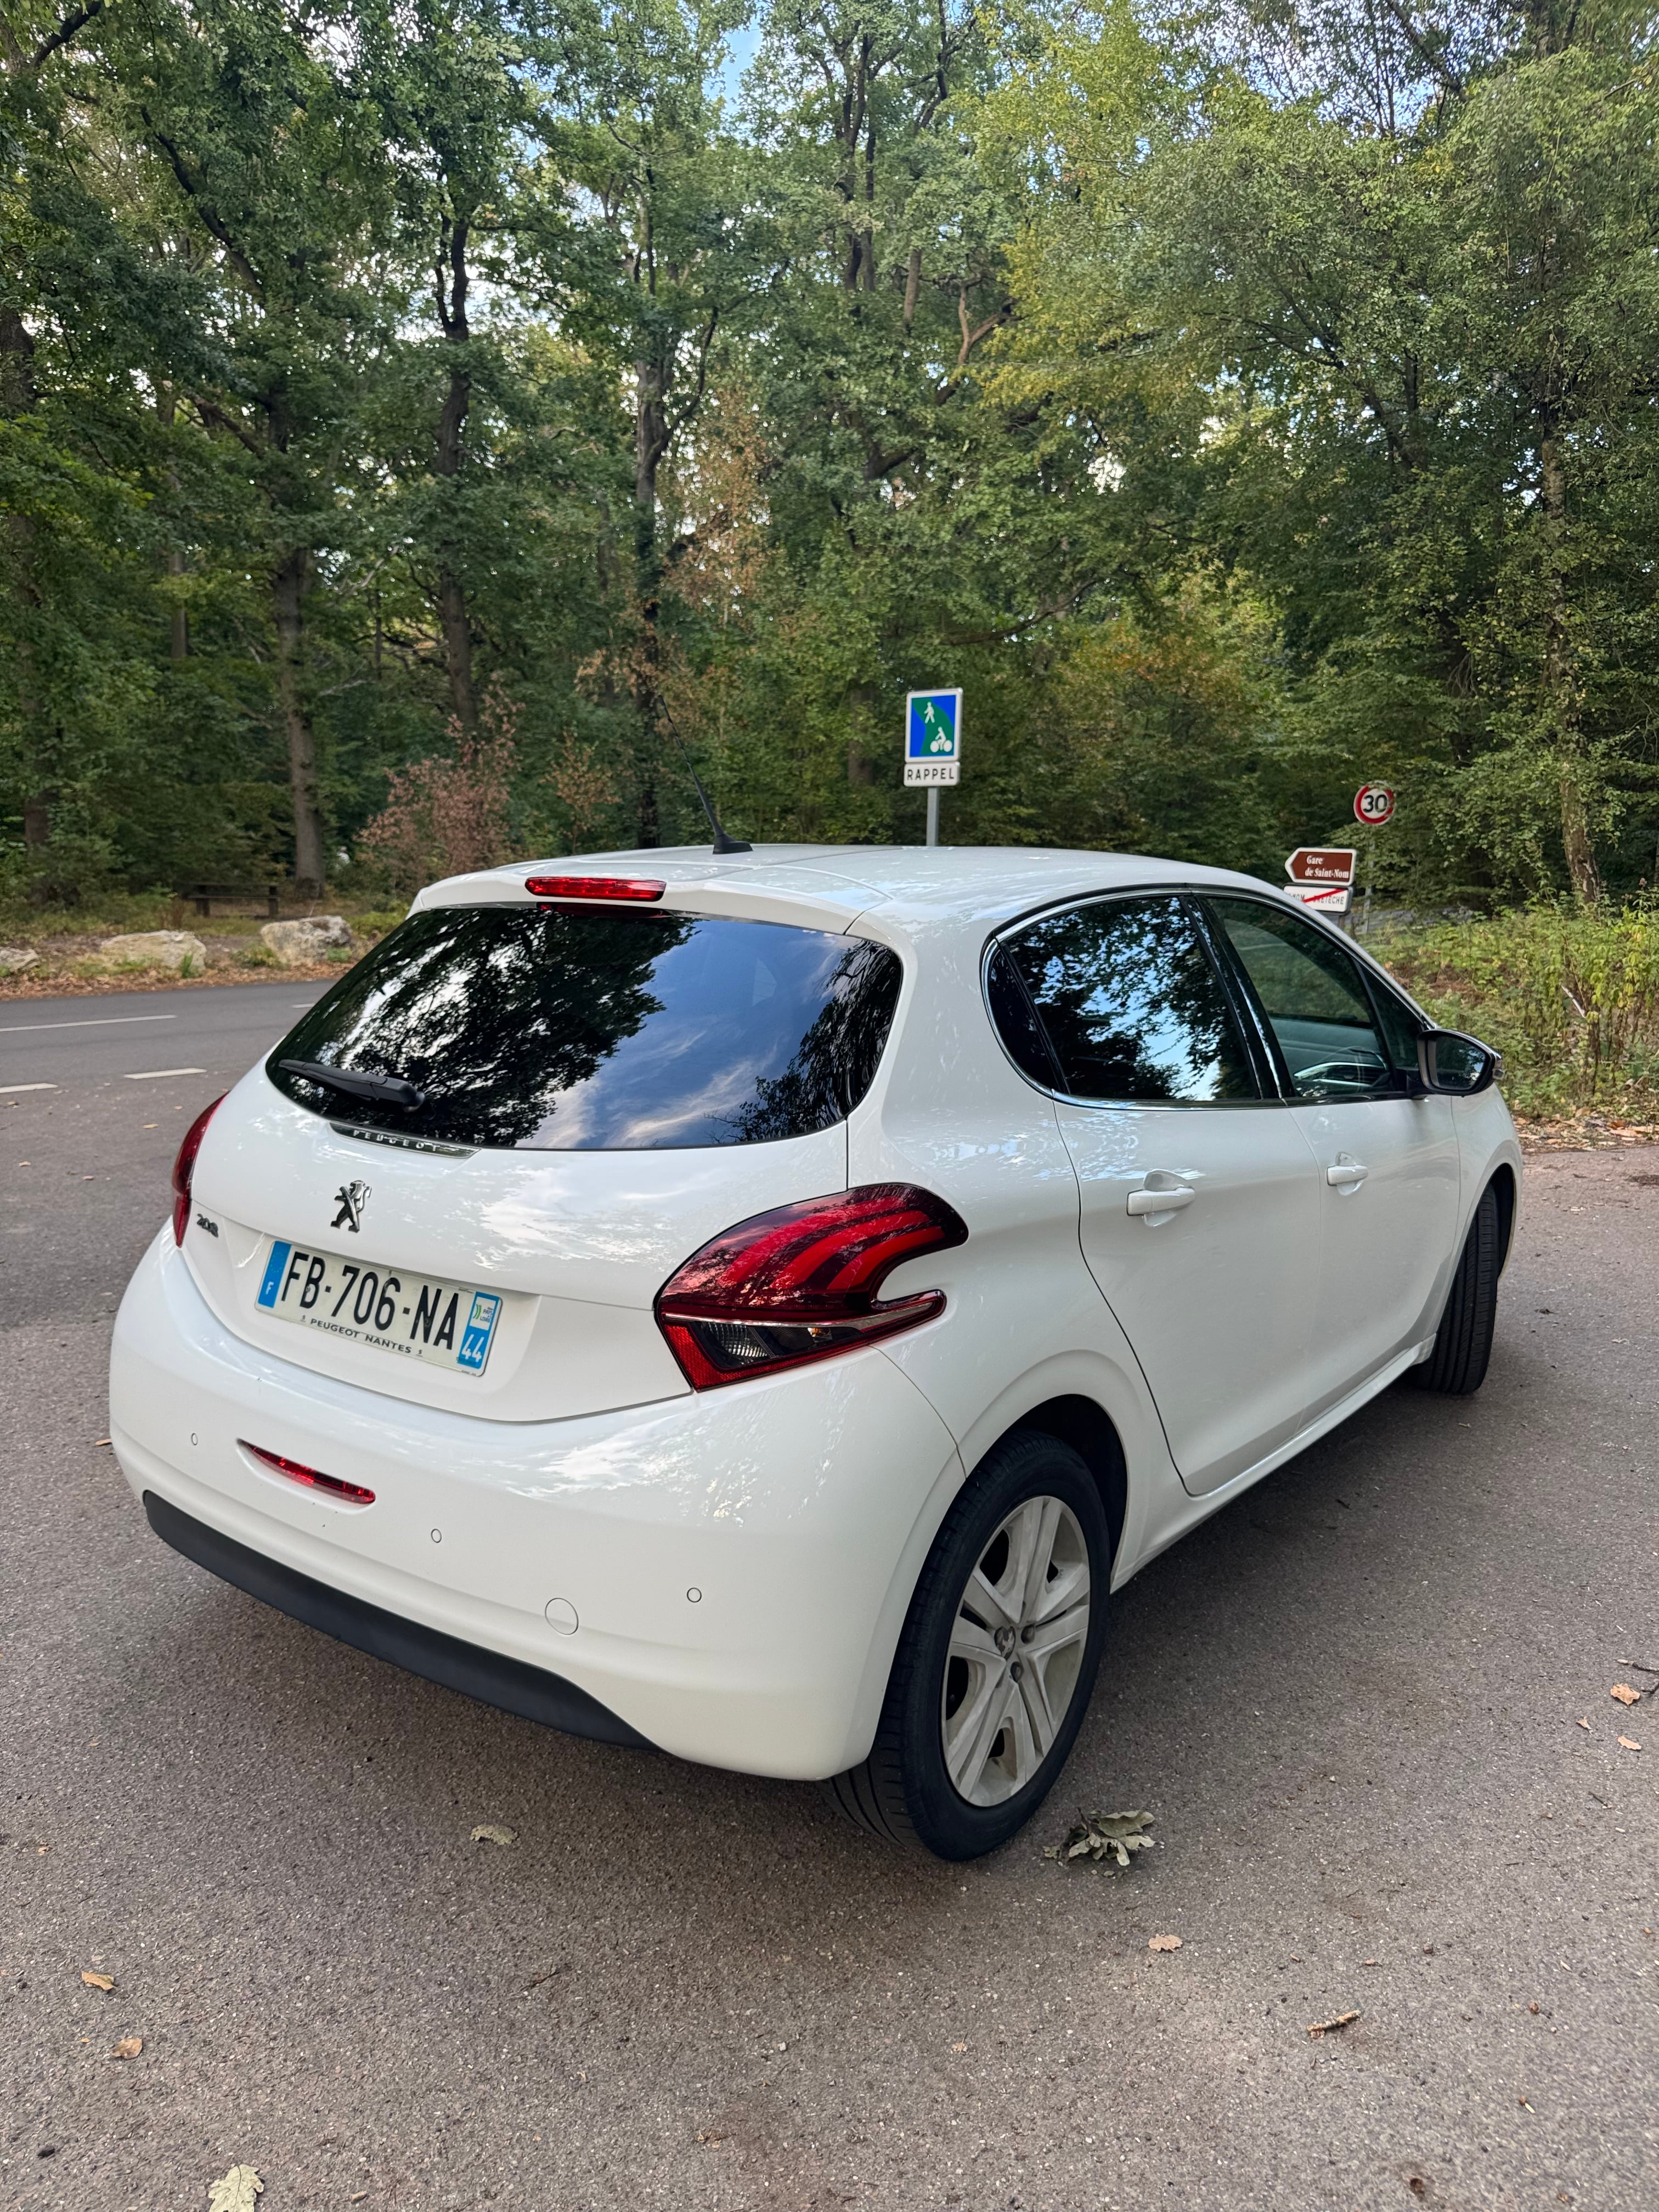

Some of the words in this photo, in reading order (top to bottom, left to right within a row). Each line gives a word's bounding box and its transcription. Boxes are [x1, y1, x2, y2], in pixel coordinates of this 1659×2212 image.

[907, 768, 955, 781] RAPPEL
[1363, 794, 1387, 813] 30
[1306, 855, 1324, 865] Gare
[1305, 867, 1314, 877] de
[1314, 867, 1349, 879] Saint-Nom
[353, 1130, 441, 1152] PEUGEOT
[266, 1281, 274, 1295] F
[280, 1251, 459, 1350] FB-706-NA
[310, 1318, 360, 1338] PEUGEOT
[365, 1334, 412, 1354] NANTES
[461, 1334, 485, 1363] 44
